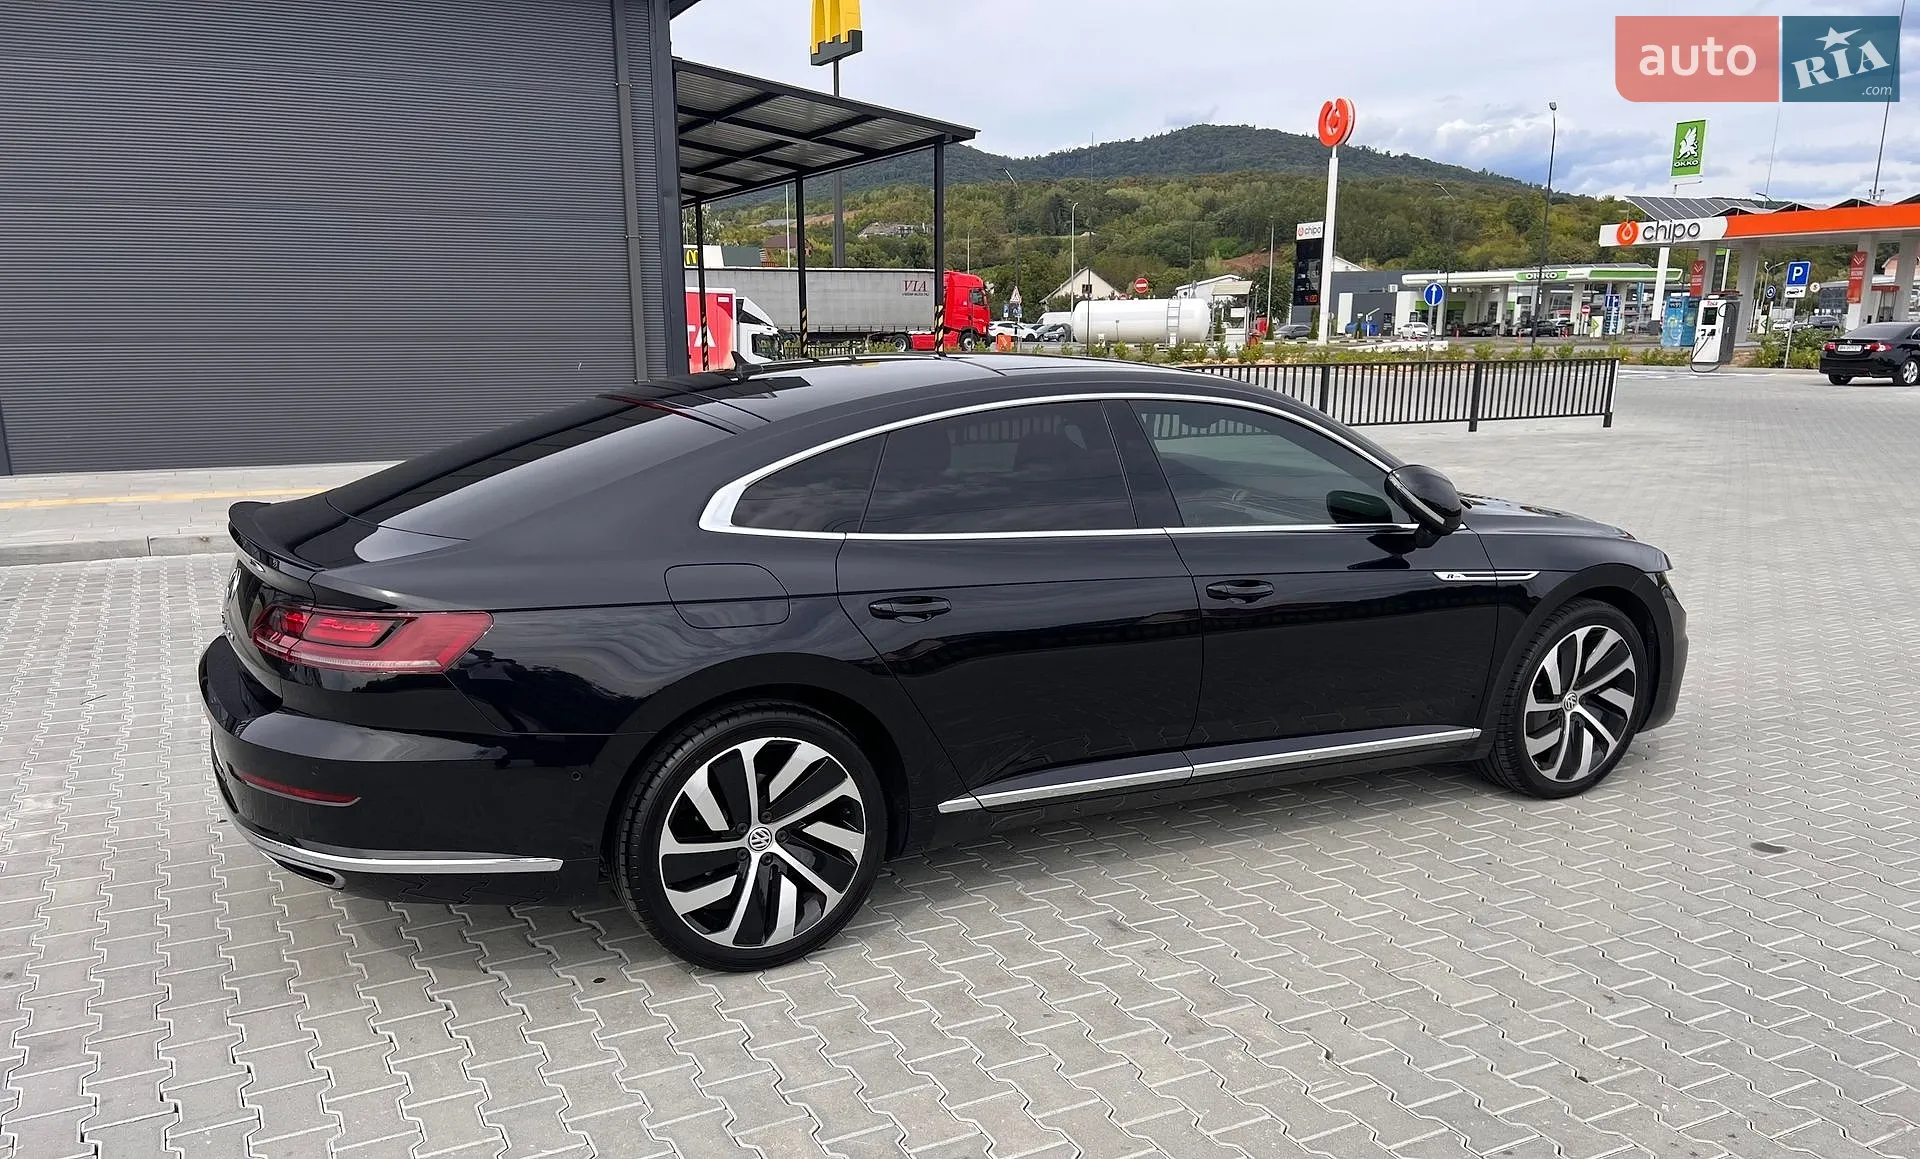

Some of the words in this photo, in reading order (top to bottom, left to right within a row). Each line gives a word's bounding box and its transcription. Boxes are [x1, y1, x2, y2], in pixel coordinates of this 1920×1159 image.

[1674, 159, 1699, 168] OKKO
[1304, 225, 1322, 235] chipo
[1642, 219, 1701, 244] chipo
[1792, 266, 1803, 282] P
[903, 280, 928, 292] VIA
